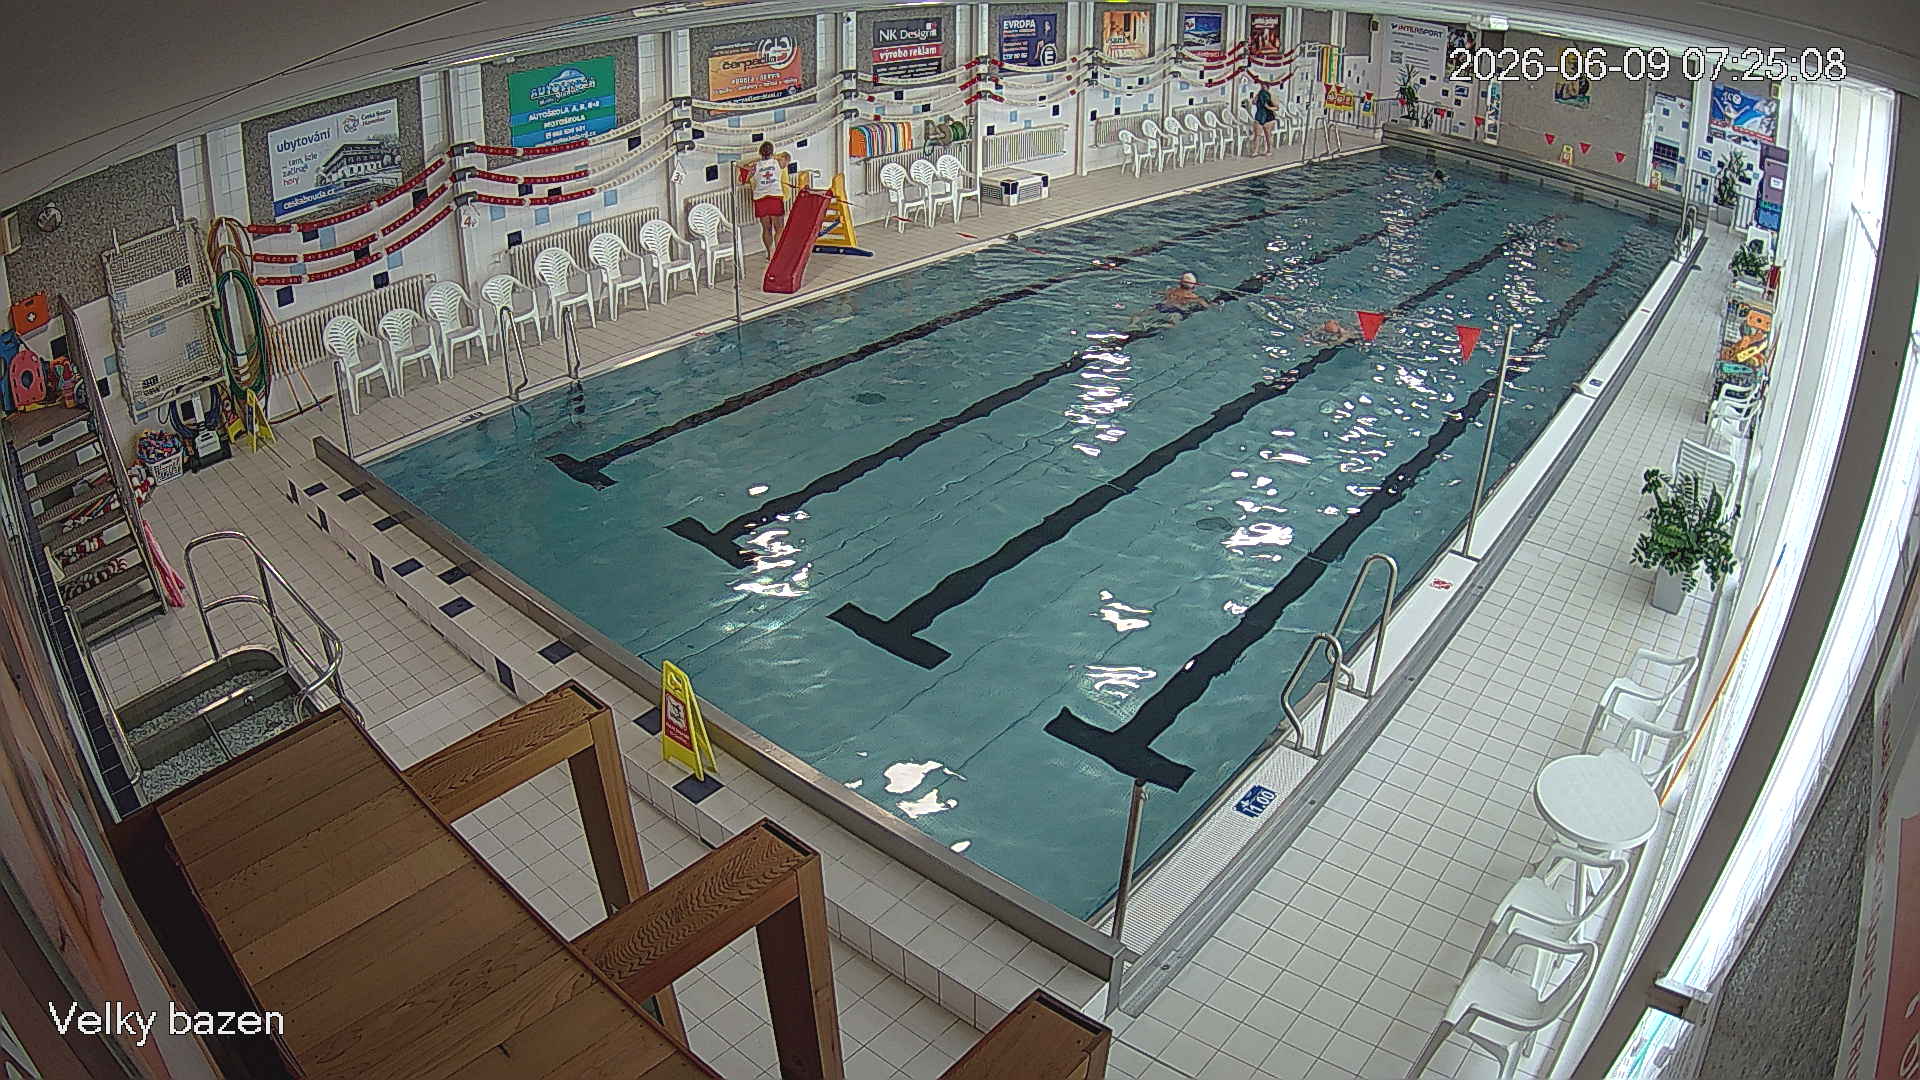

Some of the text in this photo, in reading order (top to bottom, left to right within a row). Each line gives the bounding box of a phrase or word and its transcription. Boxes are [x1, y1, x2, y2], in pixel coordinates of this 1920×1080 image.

[1003, 19, 1036, 29] EVROPA
[879, 28, 937, 41] NK Design
[879, 46, 937, 61] výroba reklam
[276, 128, 332, 153] ubytování
